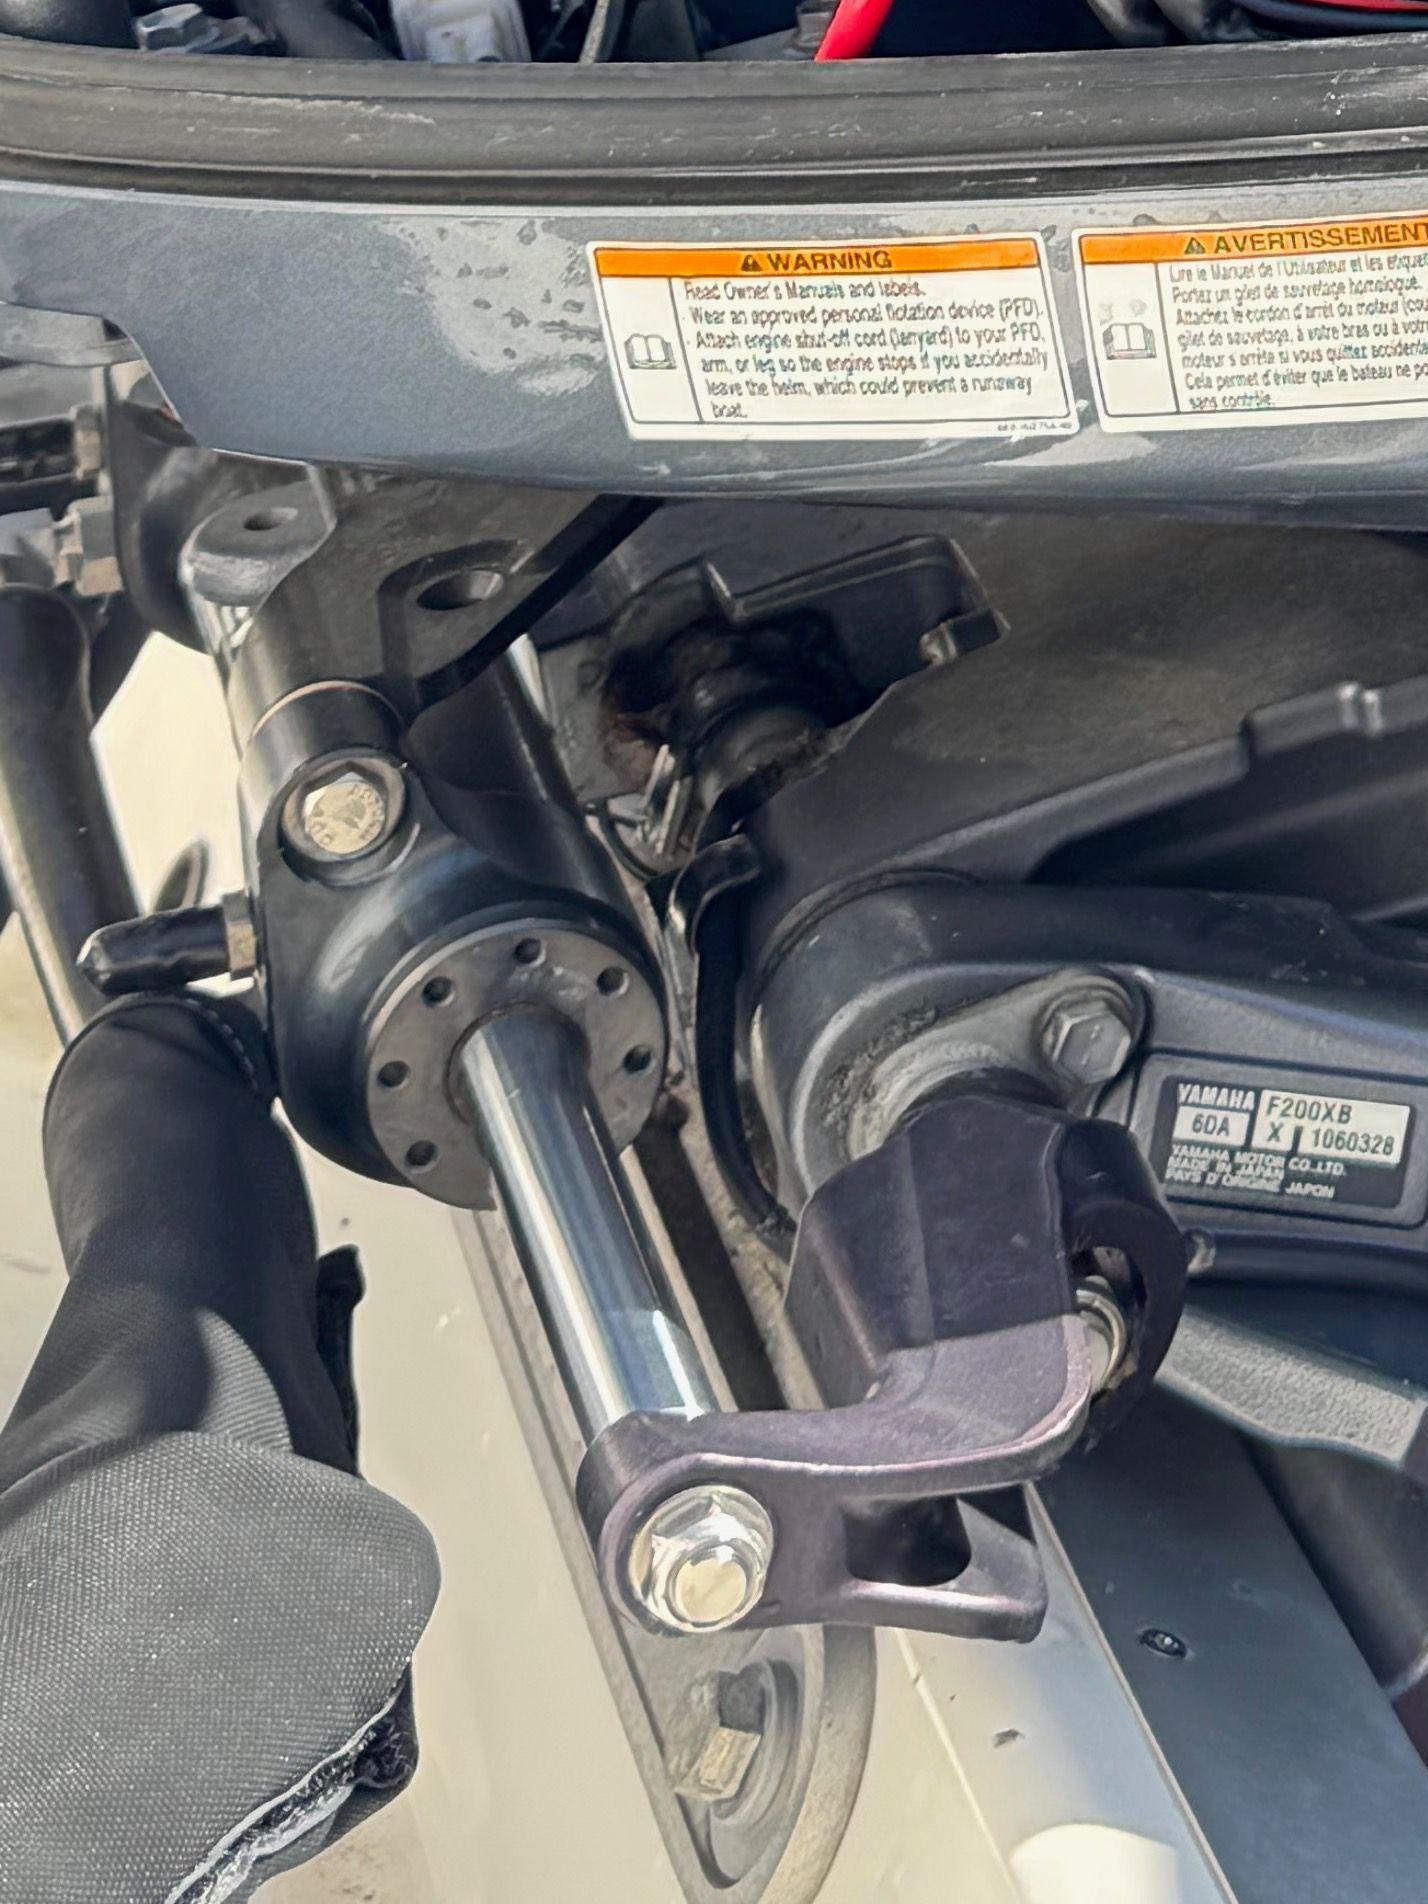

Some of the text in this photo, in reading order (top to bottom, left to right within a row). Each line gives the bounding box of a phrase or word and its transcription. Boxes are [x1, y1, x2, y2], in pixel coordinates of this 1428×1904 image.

[766, 250, 892, 271] WARNING
[684, 281, 720, 300] Read
[785, 280, 844, 299] Manuals
[848, 281, 874, 298] and
[692, 307, 723, 324] Wear
[730, 310, 748, 324] an
[751, 306, 817, 328] approved
[821, 303, 882, 328] personal
[948, 300, 994, 319] device
[1179, 1084, 1352, 1125] YAMAHA F200XB
[1192, 1113, 1395, 1156] 6DA X 1060328
[1168, 1156, 1284, 1180] MADE IN JAPAN
[1173, 1144, 1229, 1161] YAMAHA
[1234, 1151, 1285, 1168] MOTOR
[1165, 1167, 1202, 1183] PAYS
[1285, 1182, 1335, 1198] JAPON
